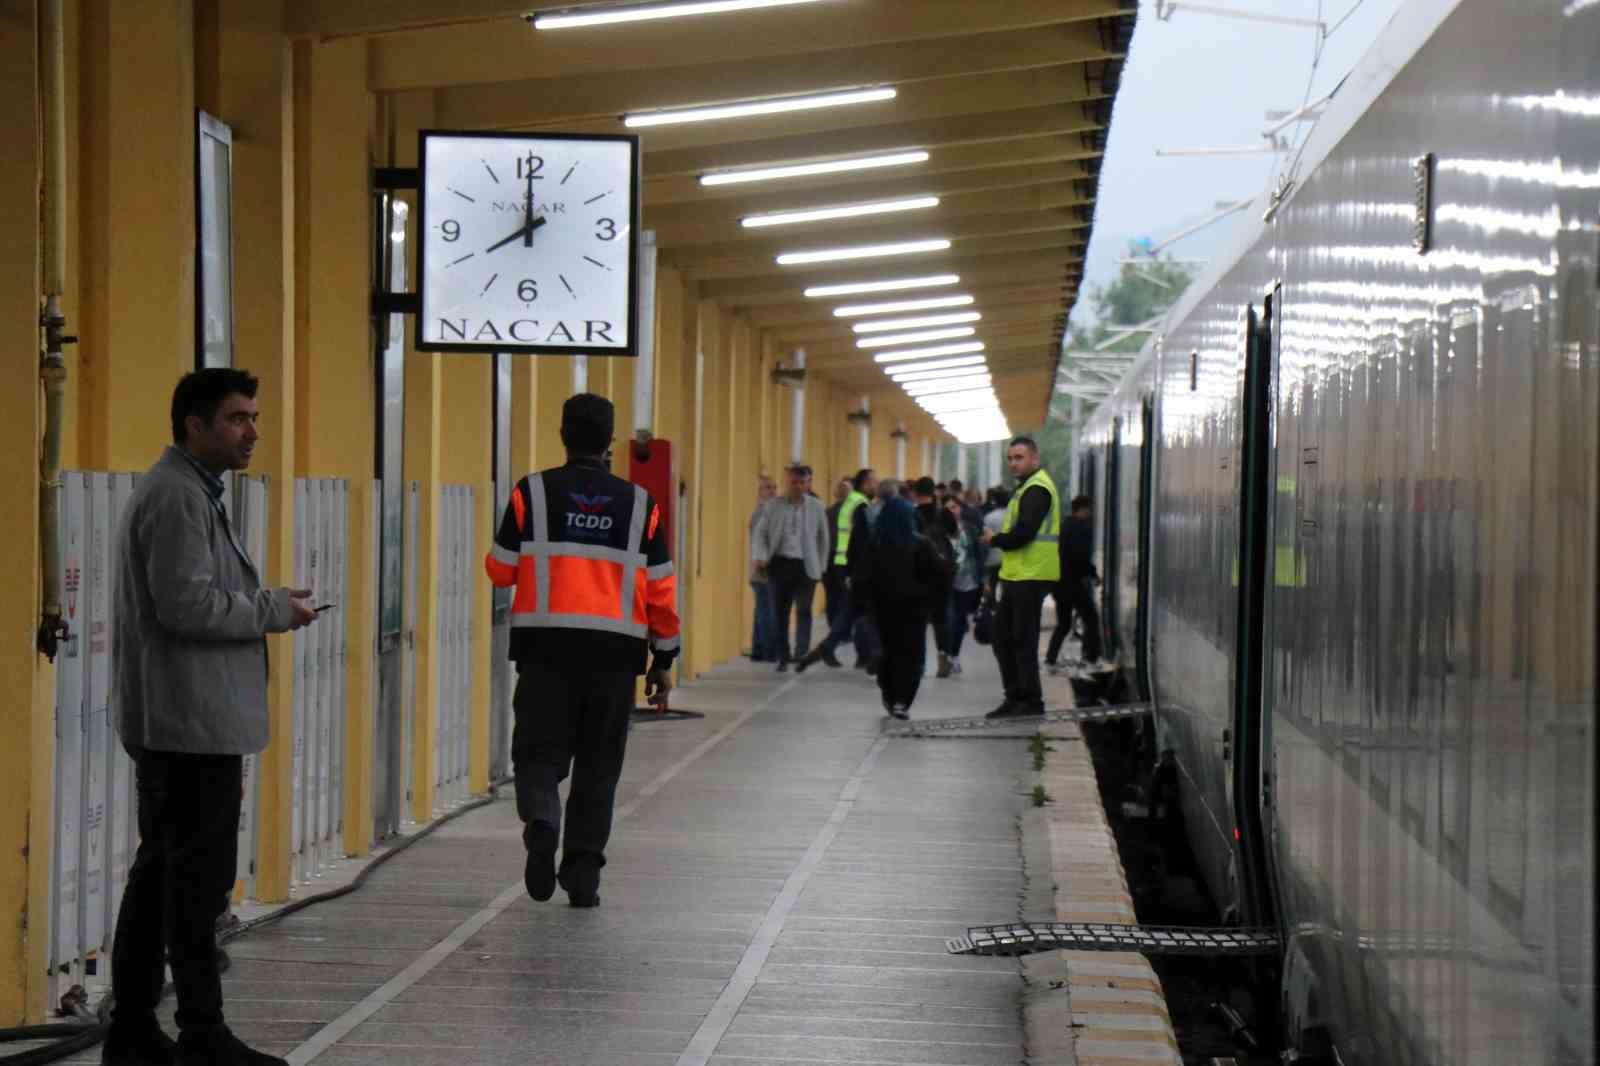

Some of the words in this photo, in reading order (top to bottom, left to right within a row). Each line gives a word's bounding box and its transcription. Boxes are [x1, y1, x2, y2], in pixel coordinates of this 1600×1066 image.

[516, 155, 544, 180] 12
[440, 219, 461, 243] 9
[595, 217, 617, 241] 3
[517, 279, 538, 303] 6
[437, 317, 615, 343] NACAR
[565, 511, 613, 530] TCDD
